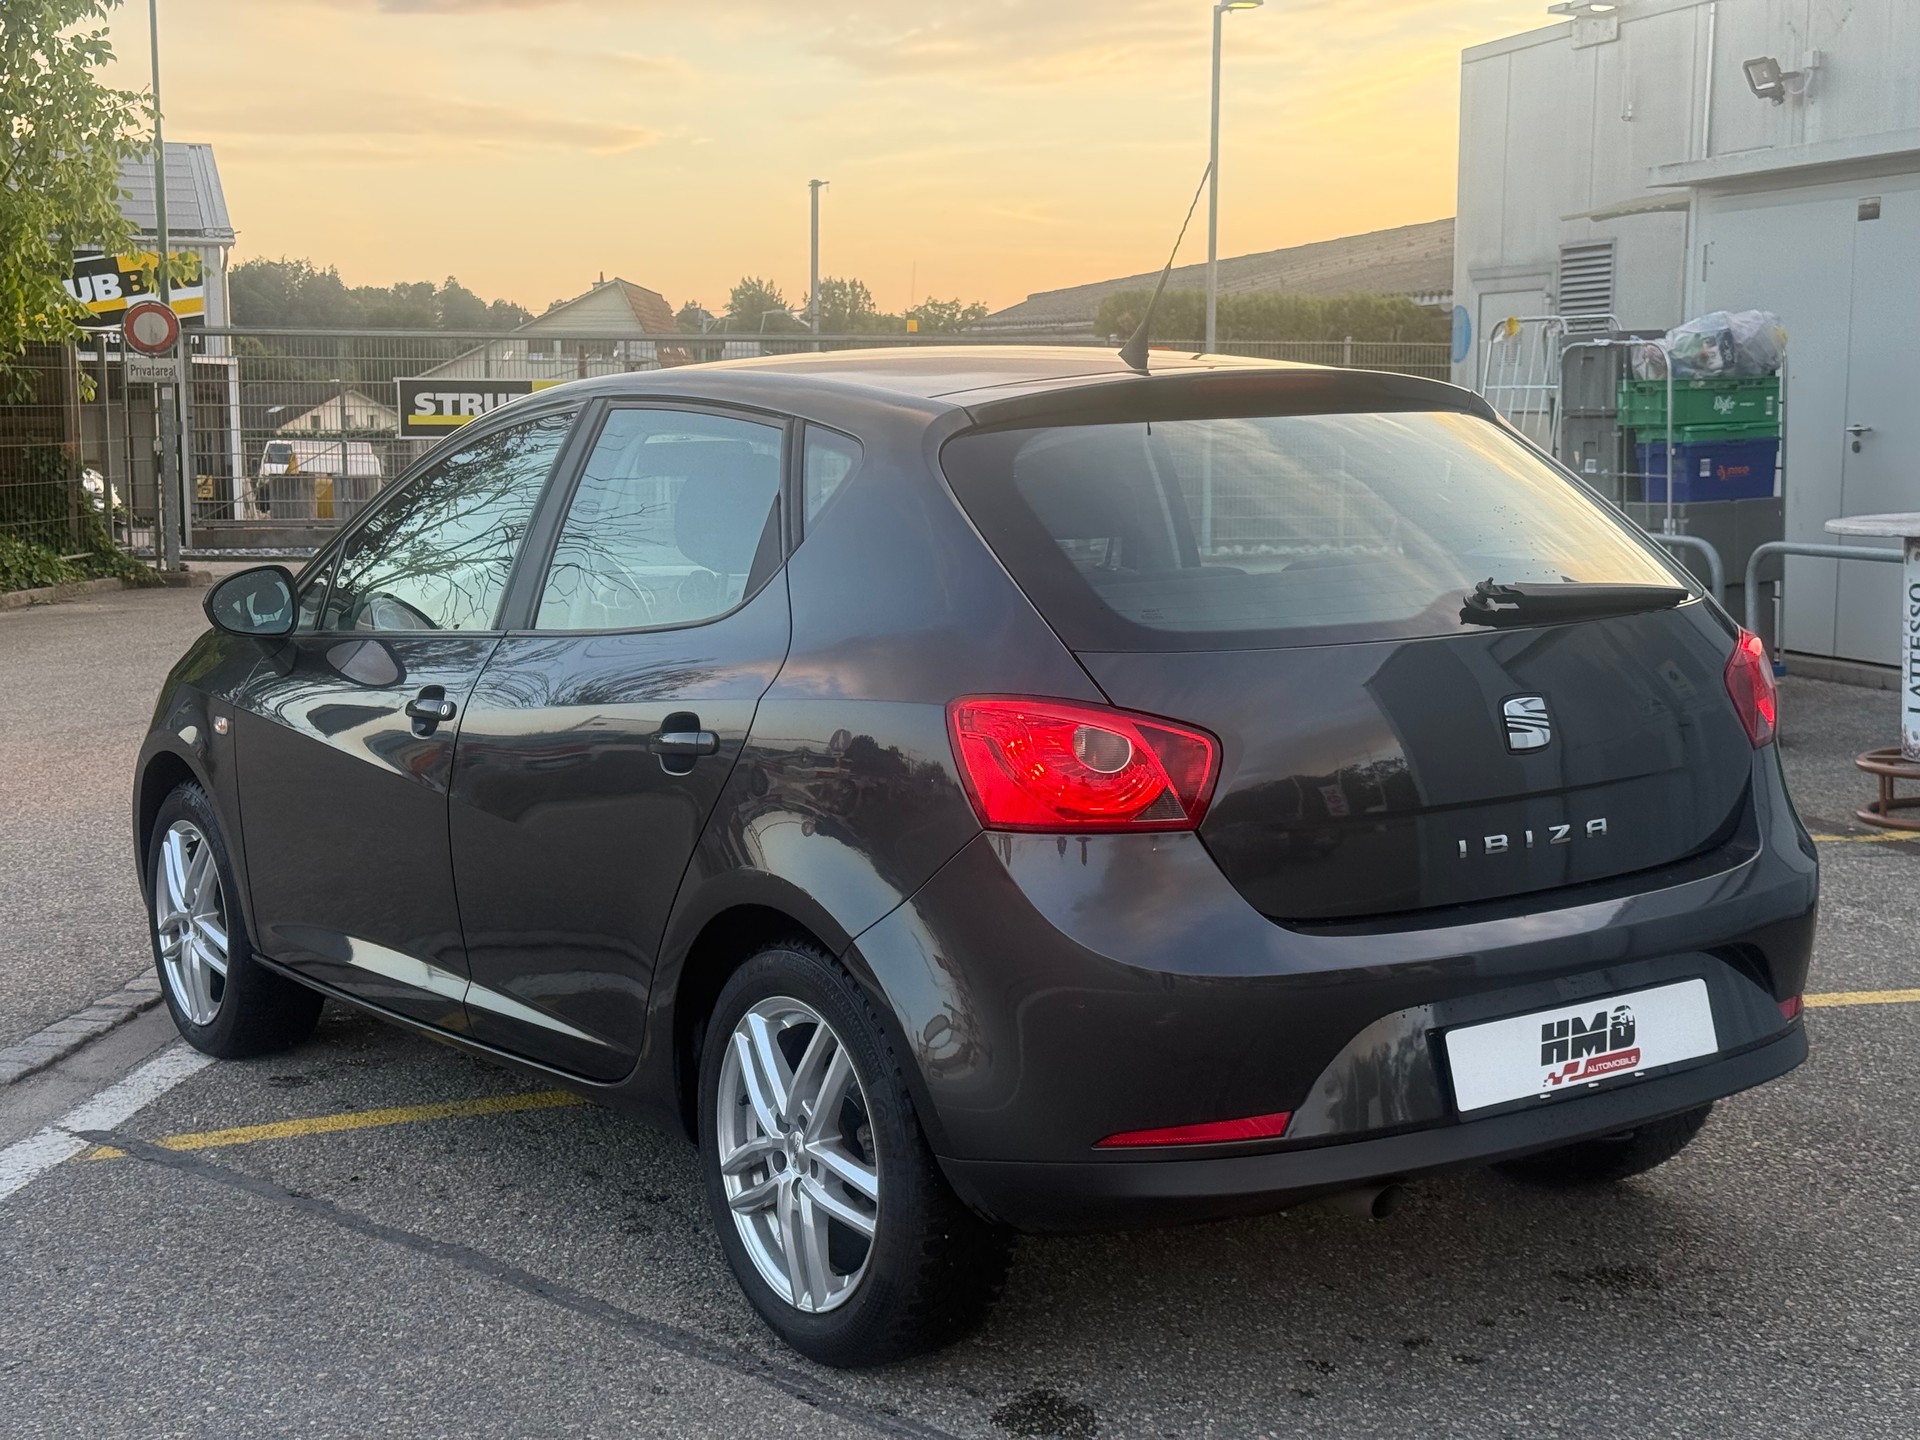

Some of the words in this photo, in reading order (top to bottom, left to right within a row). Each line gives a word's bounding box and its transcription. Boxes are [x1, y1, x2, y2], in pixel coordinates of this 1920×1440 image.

[130, 364, 176, 377] Privatareal
[414, 392, 530, 416] STRU
[1458, 817, 1608, 858] IBIZA
[1587, 1055, 1637, 1073] AUTOMOBILE
